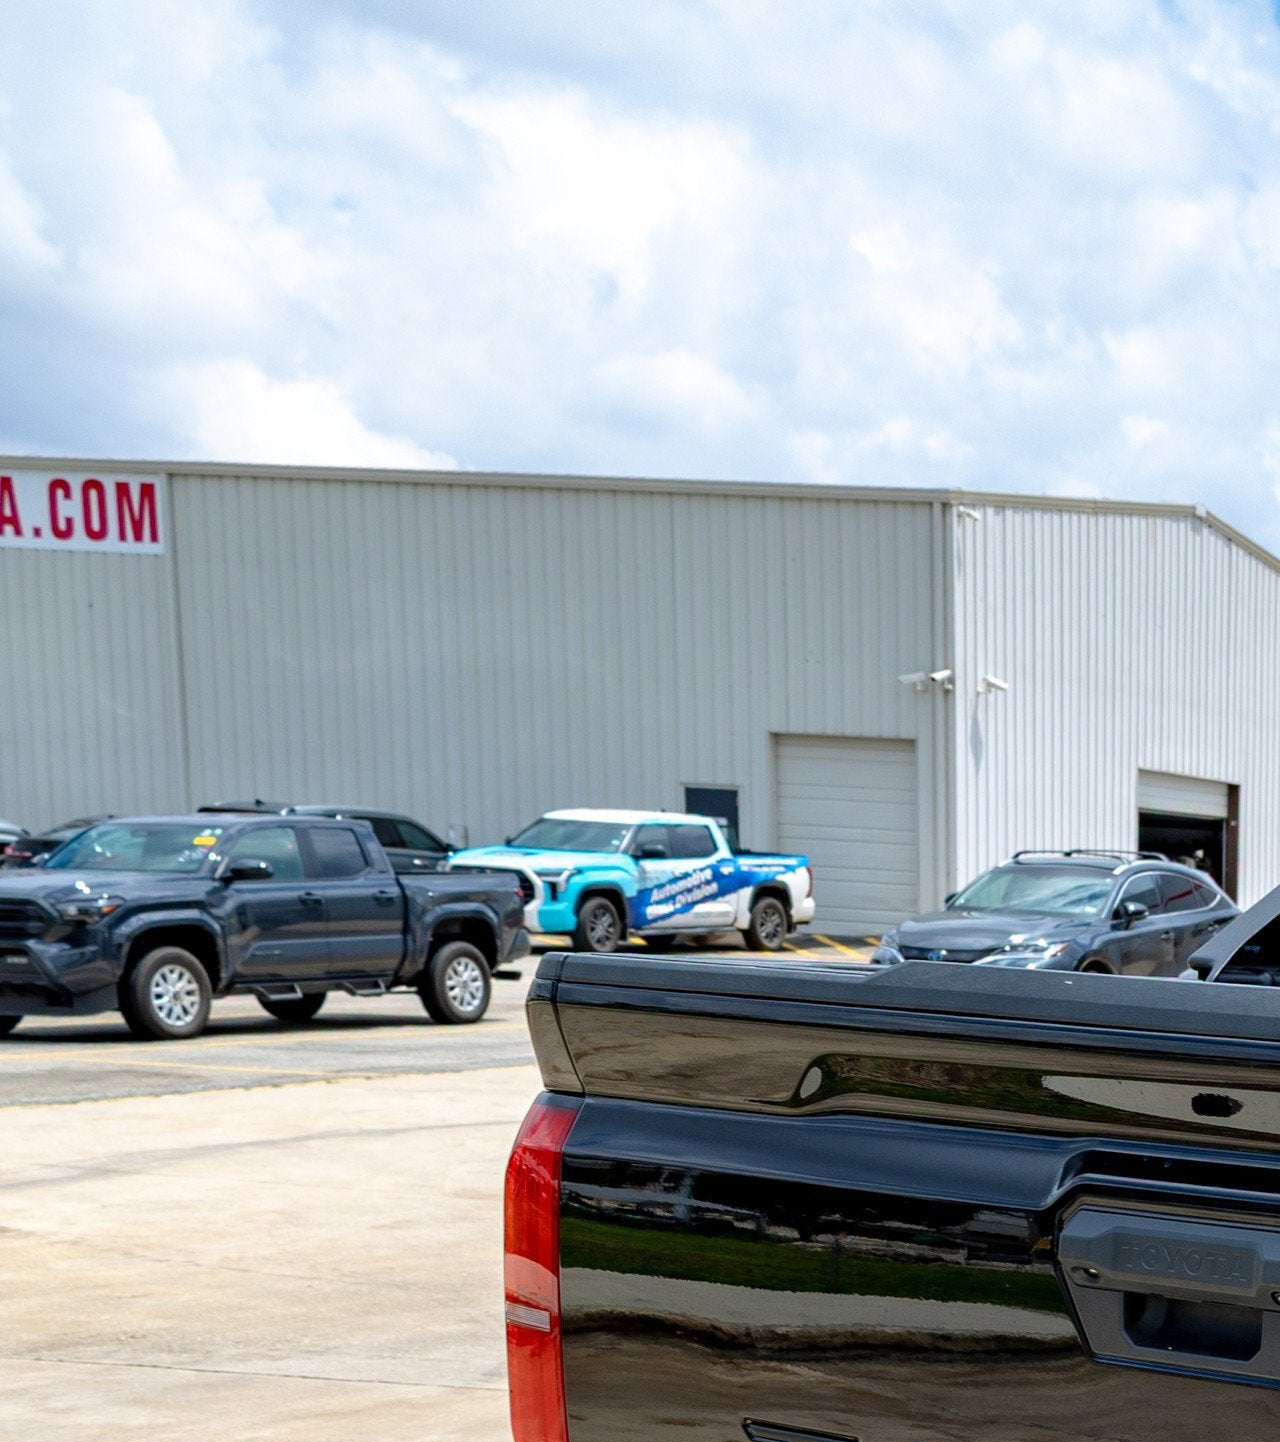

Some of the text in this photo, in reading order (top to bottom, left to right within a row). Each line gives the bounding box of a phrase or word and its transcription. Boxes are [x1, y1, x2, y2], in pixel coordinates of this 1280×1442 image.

[650, 868, 714, 904] Automotive
[674, 881, 718, 909] Division
[1120, 1240, 1248, 1283] TOYOTA
